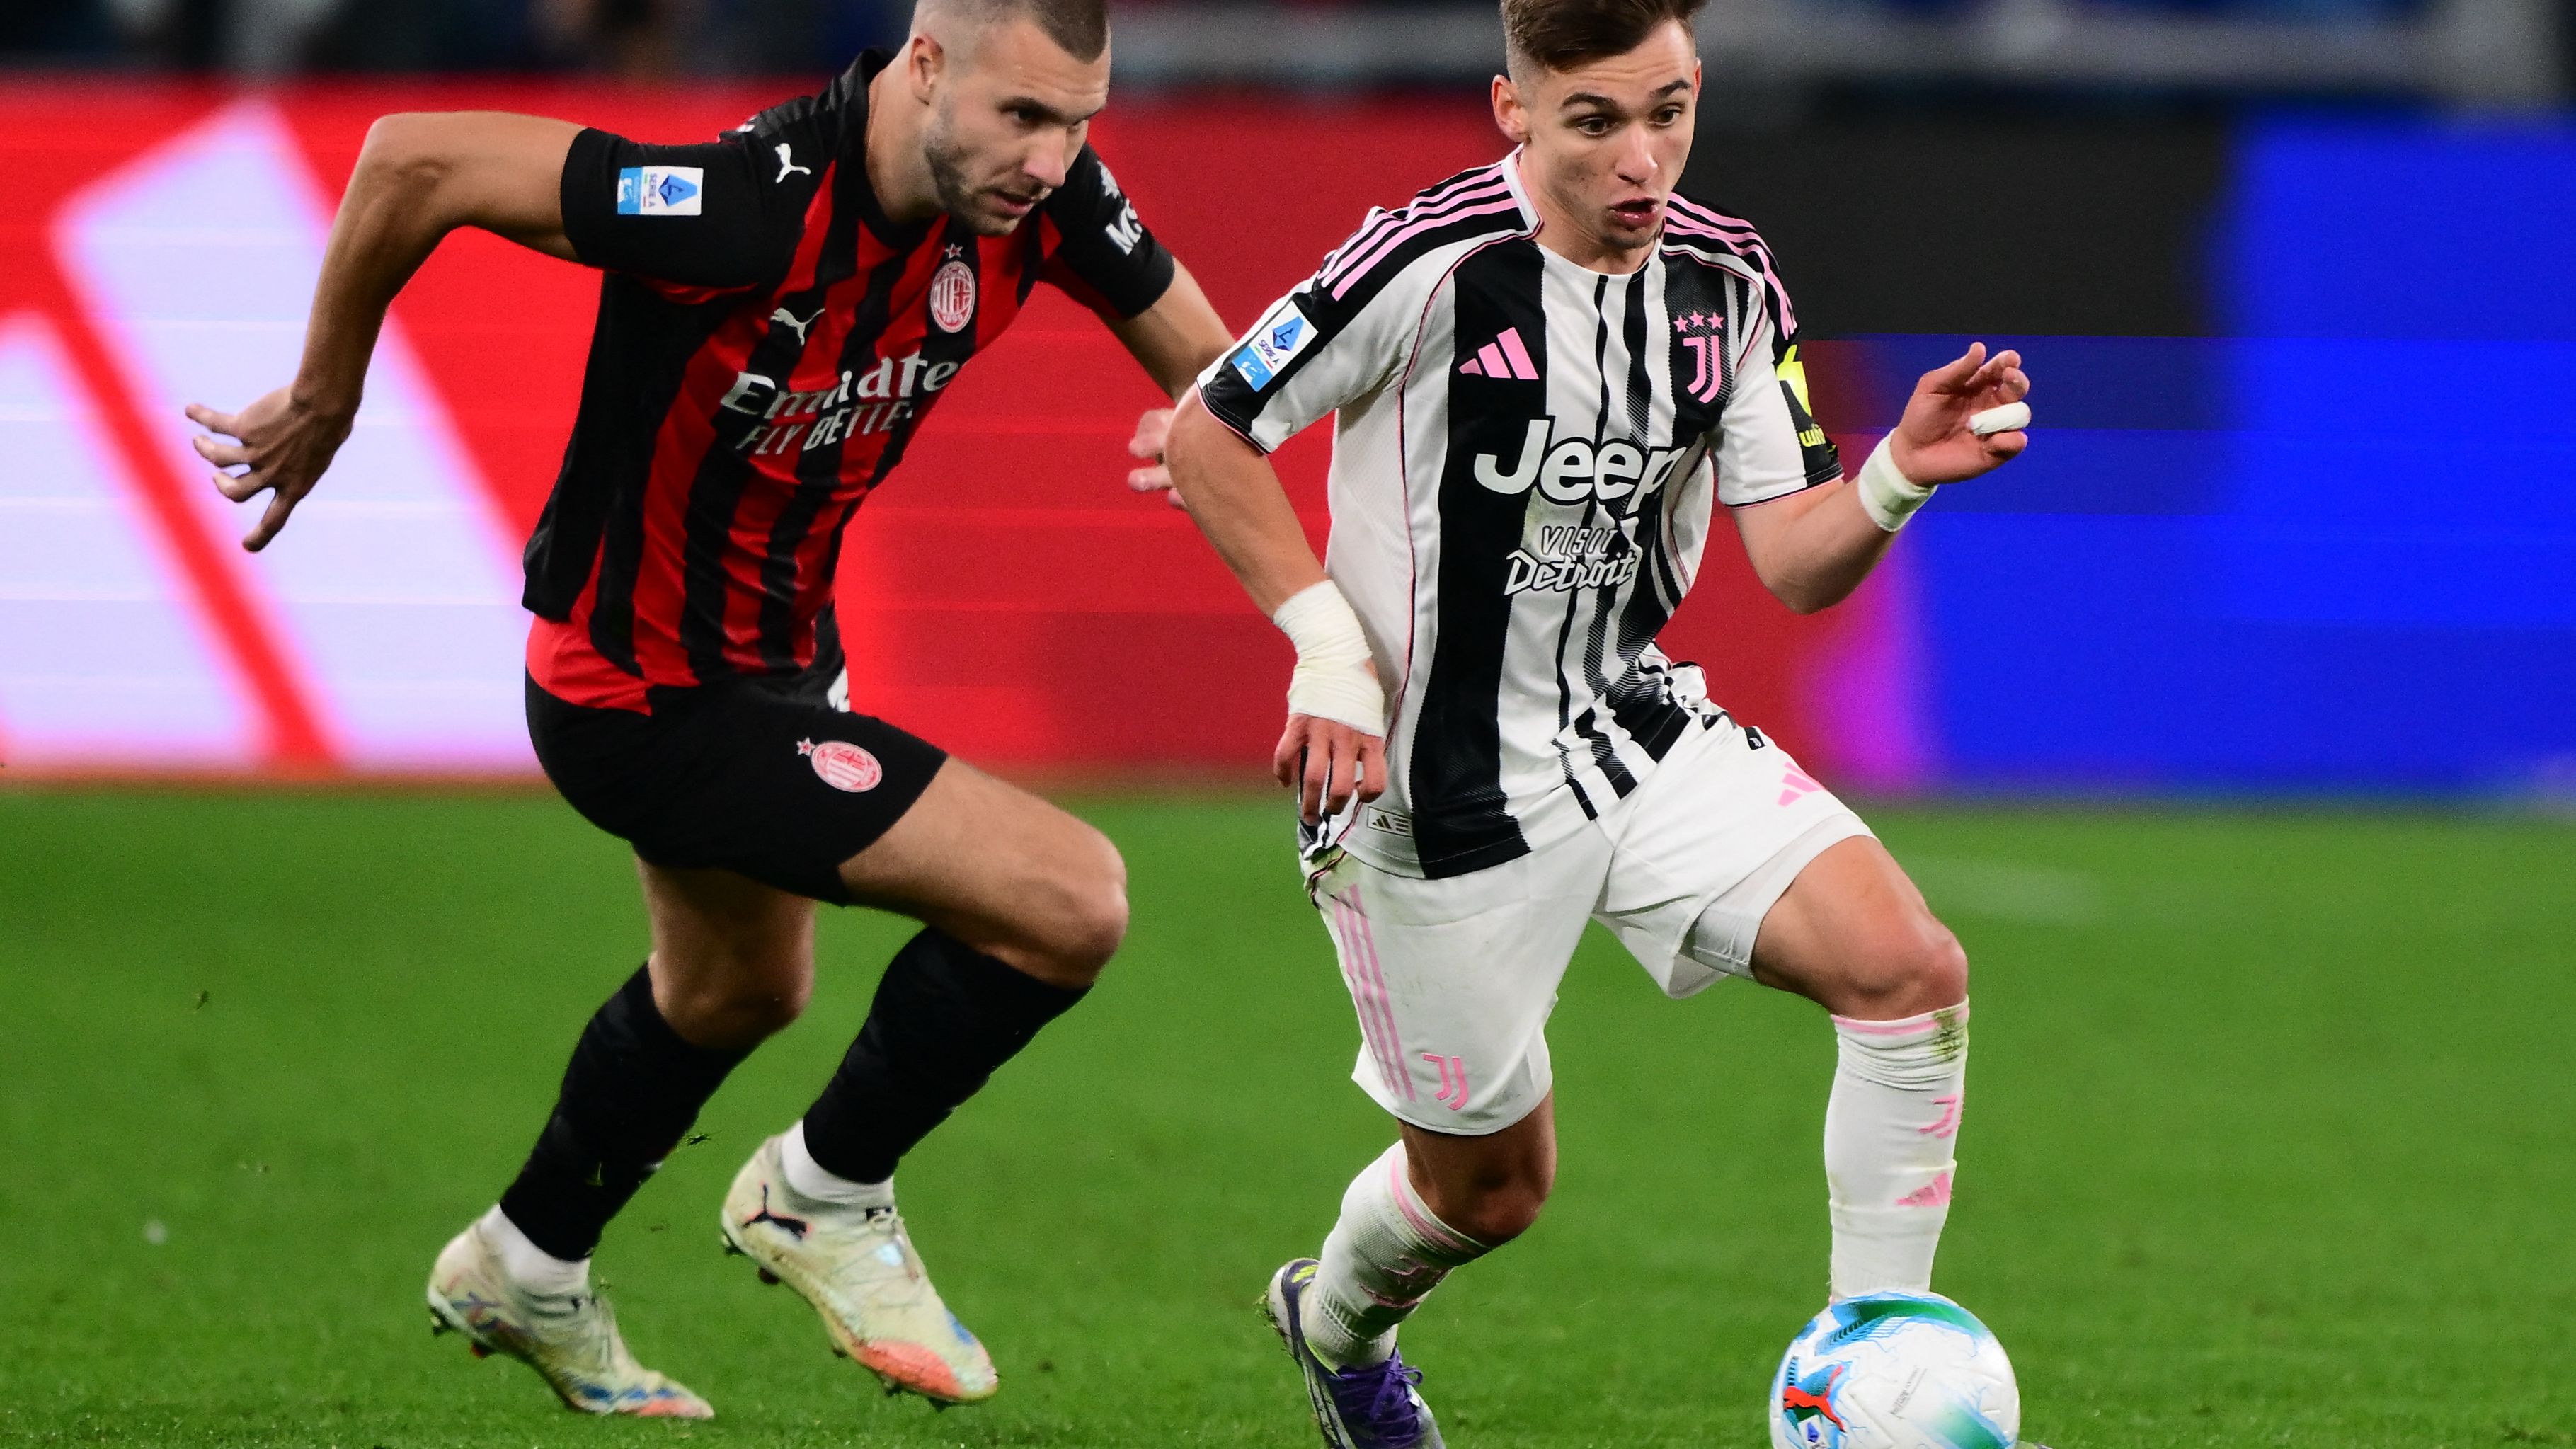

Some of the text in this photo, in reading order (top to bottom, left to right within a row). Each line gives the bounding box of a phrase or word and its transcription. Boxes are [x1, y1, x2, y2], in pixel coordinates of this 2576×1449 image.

[648, 173, 657, 198] SERIE
[1259, 339, 1276, 360] SERIE
[720, 350, 959, 420] Emirate
[735, 401, 913, 455] FLY BETTE
[1474, 419, 1688, 515] Jeep
[1542, 527, 1618, 554] VISIT
[1504, 549, 1637, 596] Detroit
